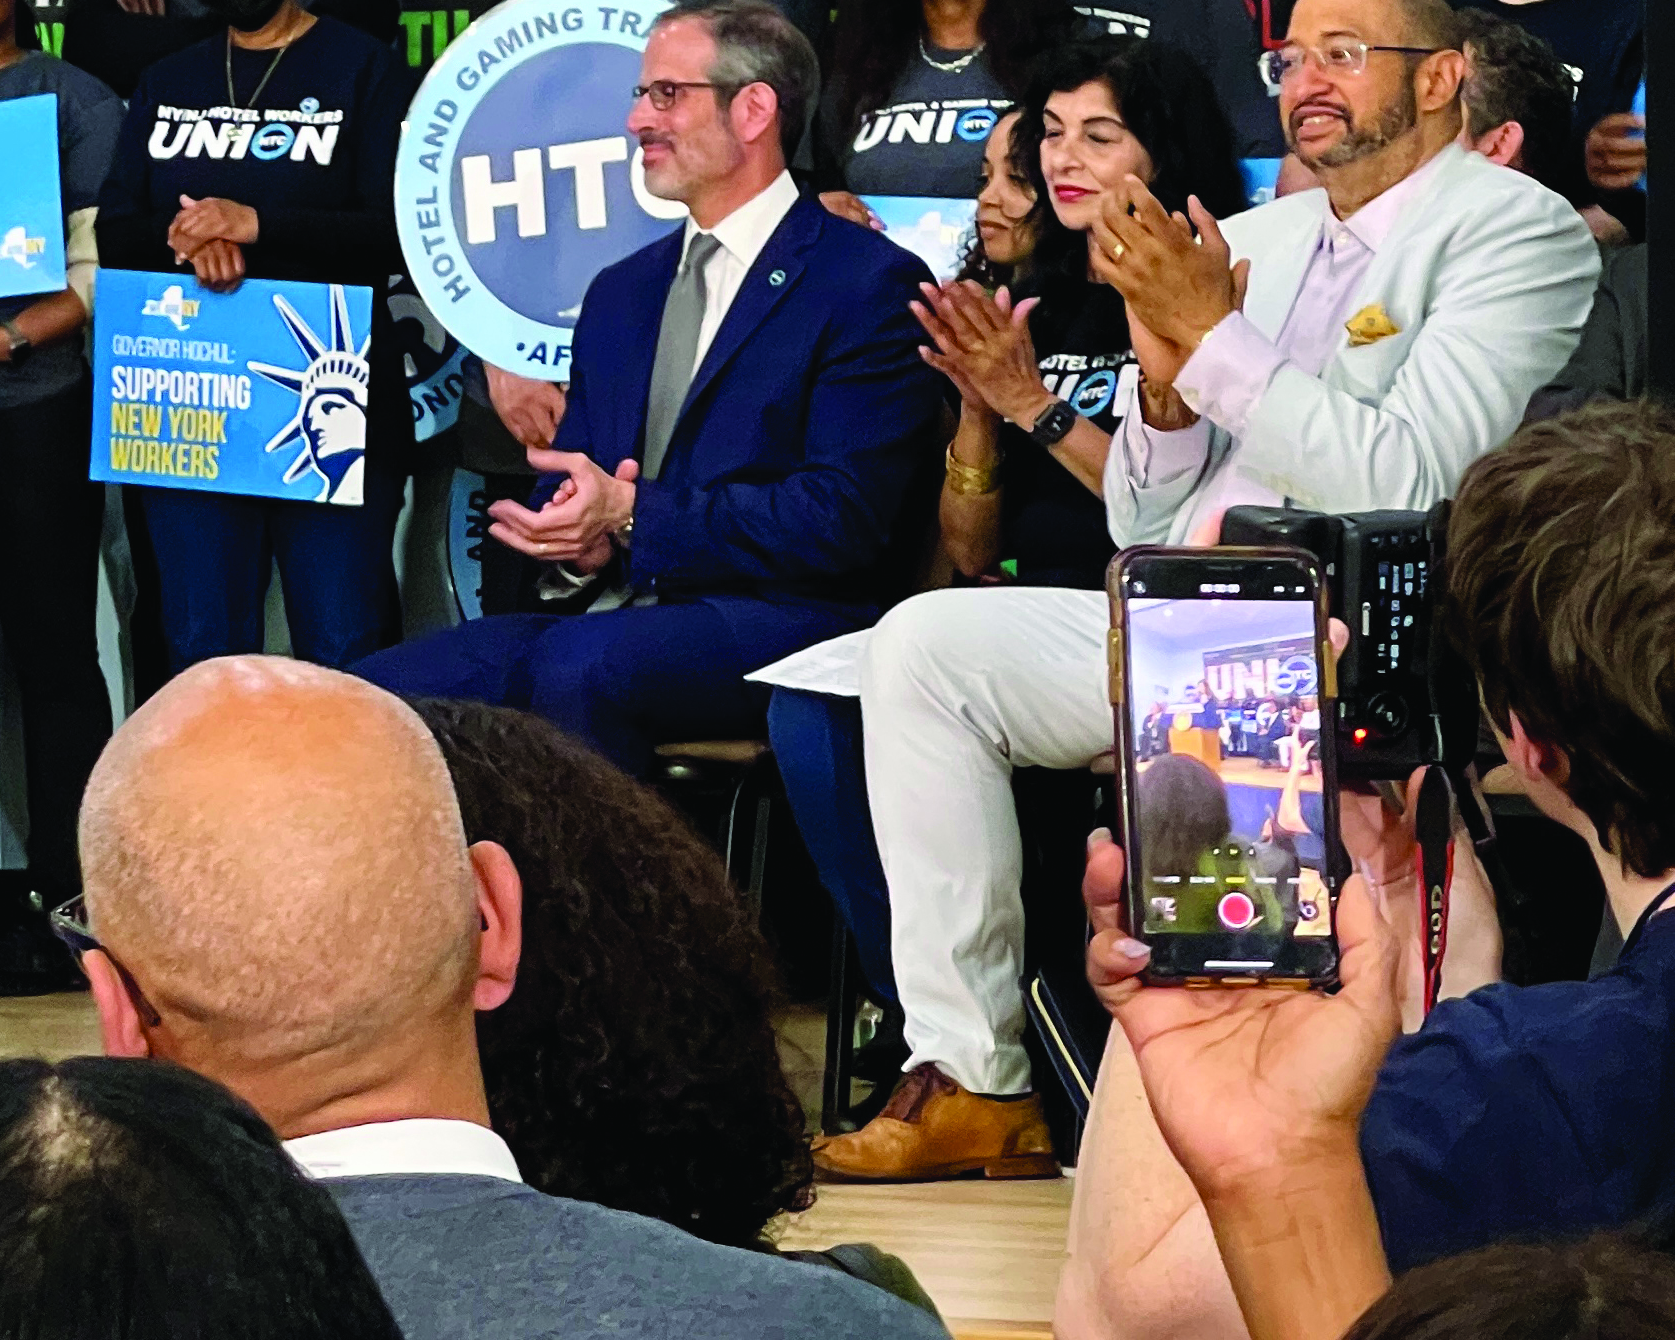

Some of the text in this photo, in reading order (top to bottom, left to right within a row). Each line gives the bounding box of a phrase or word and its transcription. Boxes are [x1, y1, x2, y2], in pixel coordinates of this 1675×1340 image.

[455, 6, 585, 92] GAMING
[208, 106, 261, 122] HOTEL
[418, 98, 459, 175] AND
[853, 107, 999, 153] UNIO
[147, 119, 340, 166] UNION
[415, 185, 472, 305] HOTEL
[112, 334, 181, 359] GOVERNOR
[111, 364, 252, 410] SUPPORTING
[111, 401, 228, 444] NEW YORK
[110, 436, 220, 480] WORKERS
